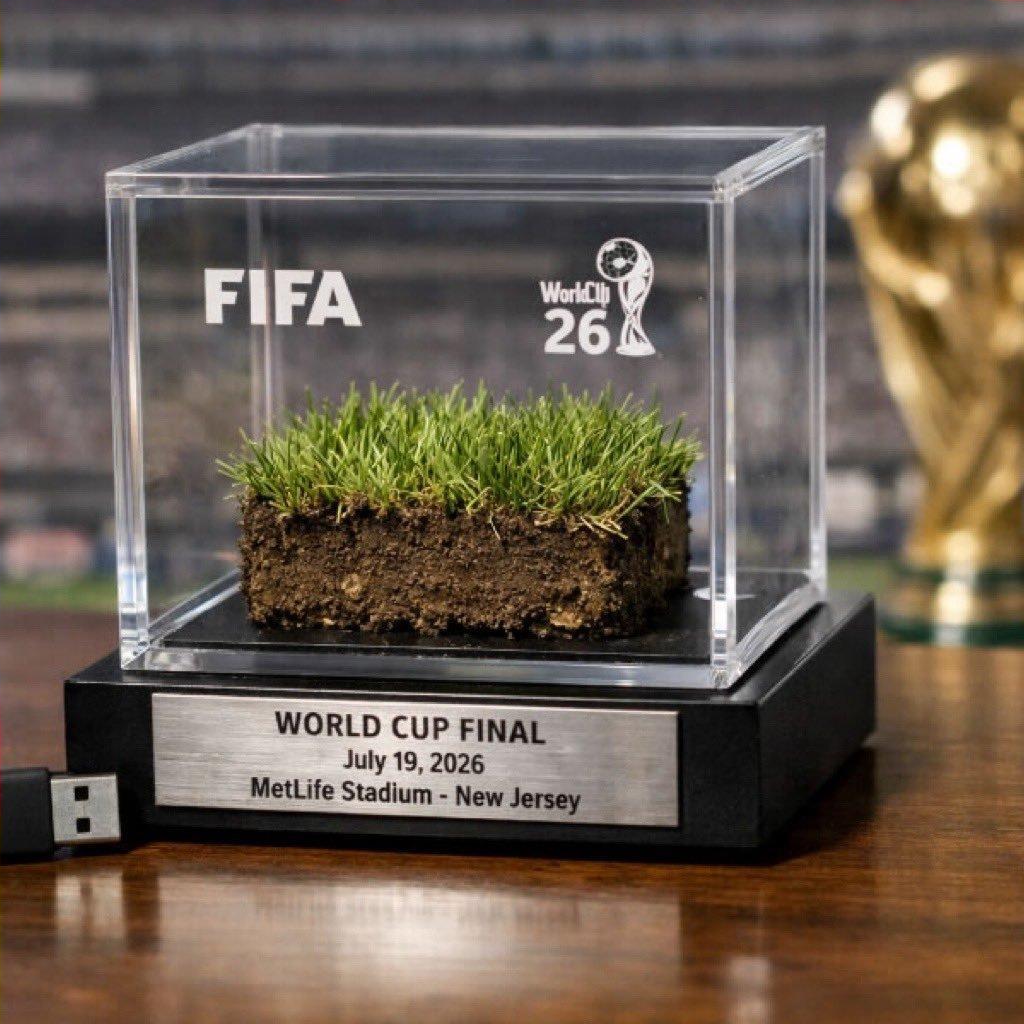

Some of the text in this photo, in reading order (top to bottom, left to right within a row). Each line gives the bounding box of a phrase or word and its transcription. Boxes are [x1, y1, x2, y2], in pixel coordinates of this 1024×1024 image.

[204, 268, 362, 326] FIFA
[544, 308, 611, 355] 26
[275, 711, 546, 744] WORLD CUP FINAL
[342, 749, 486, 775] July 19, 2026
[250, 777, 335, 801] MetLife
[342, 780, 432, 804] Stadium
[455, 785, 504, 808] New
[510, 787, 581, 815] Jersey
